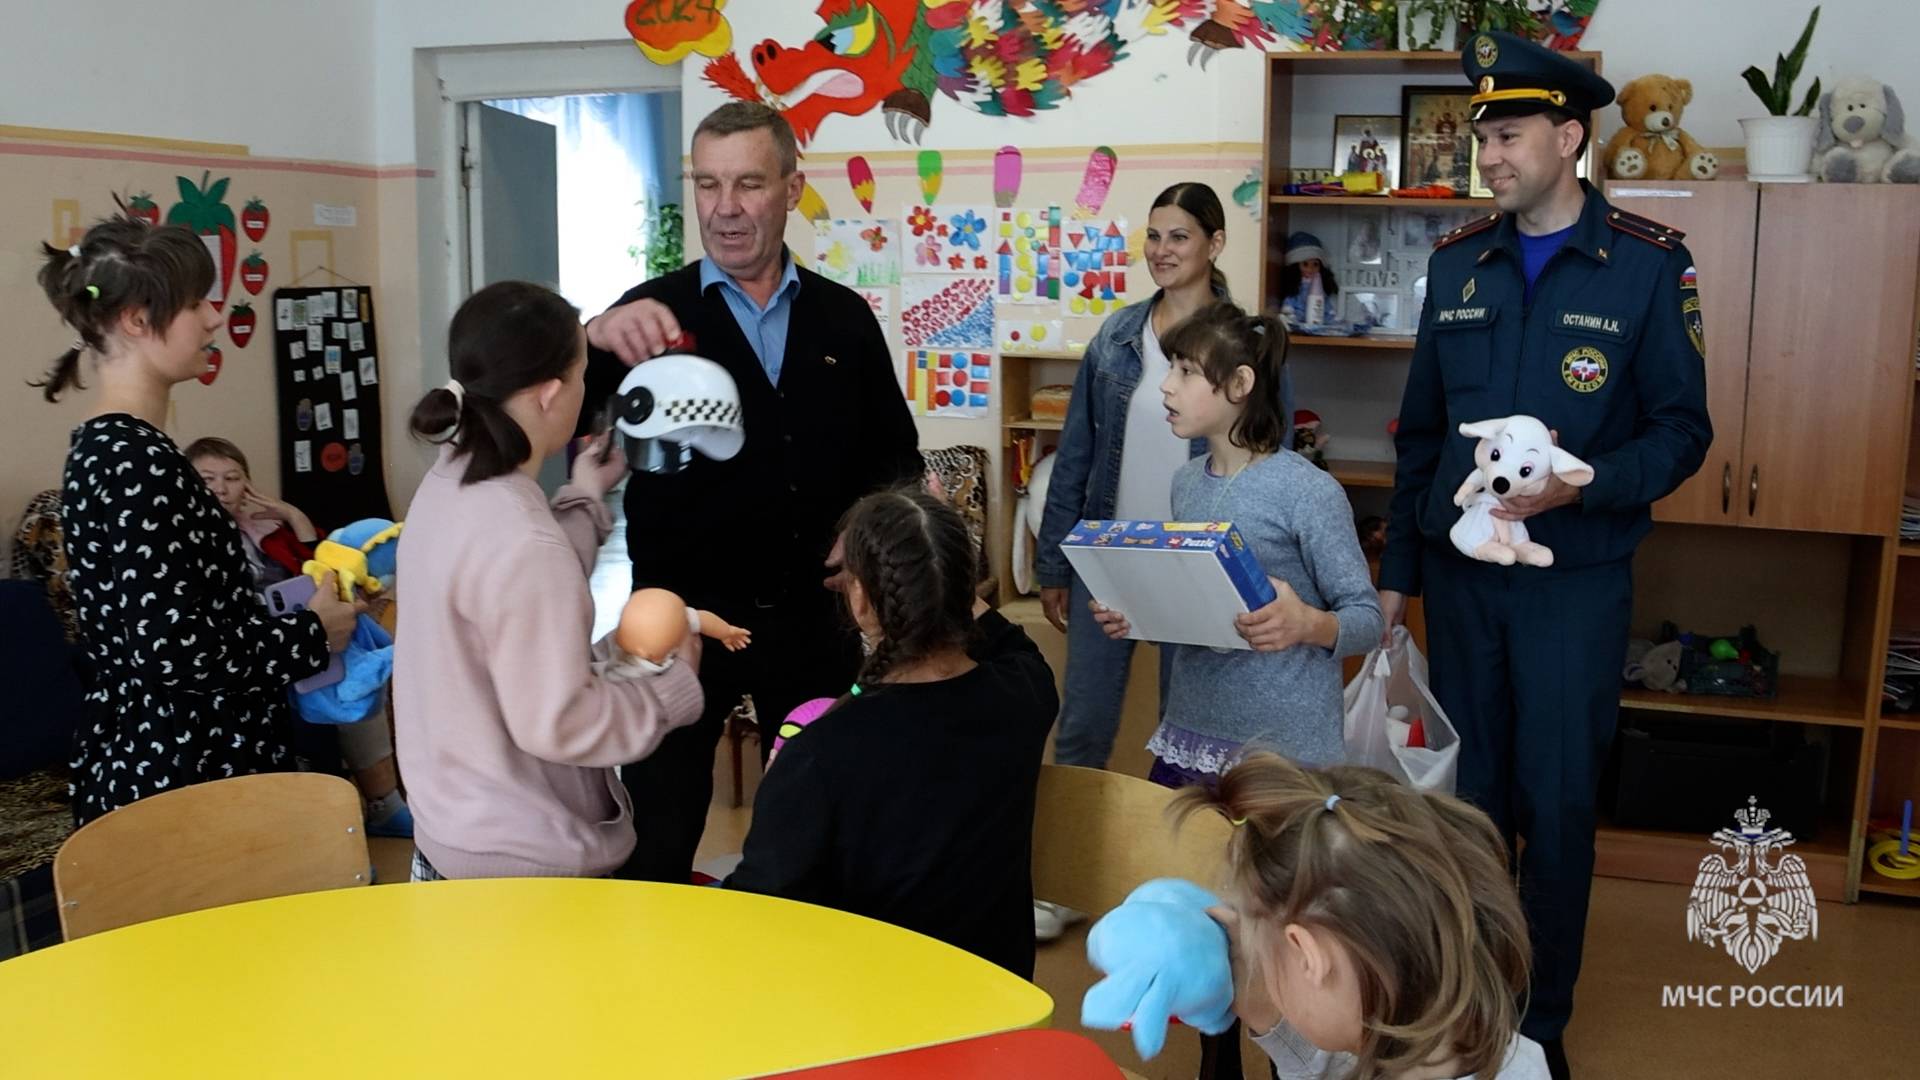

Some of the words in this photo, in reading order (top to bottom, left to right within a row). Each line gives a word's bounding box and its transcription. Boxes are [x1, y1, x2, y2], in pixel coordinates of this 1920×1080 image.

[1439, 310, 1455, 321] МЧС
[1455, 308, 1486, 320] РОССИИ
[1563, 313, 1602, 329] ОСТАНИН
[1181, 536, 1217, 548] Puzzle
